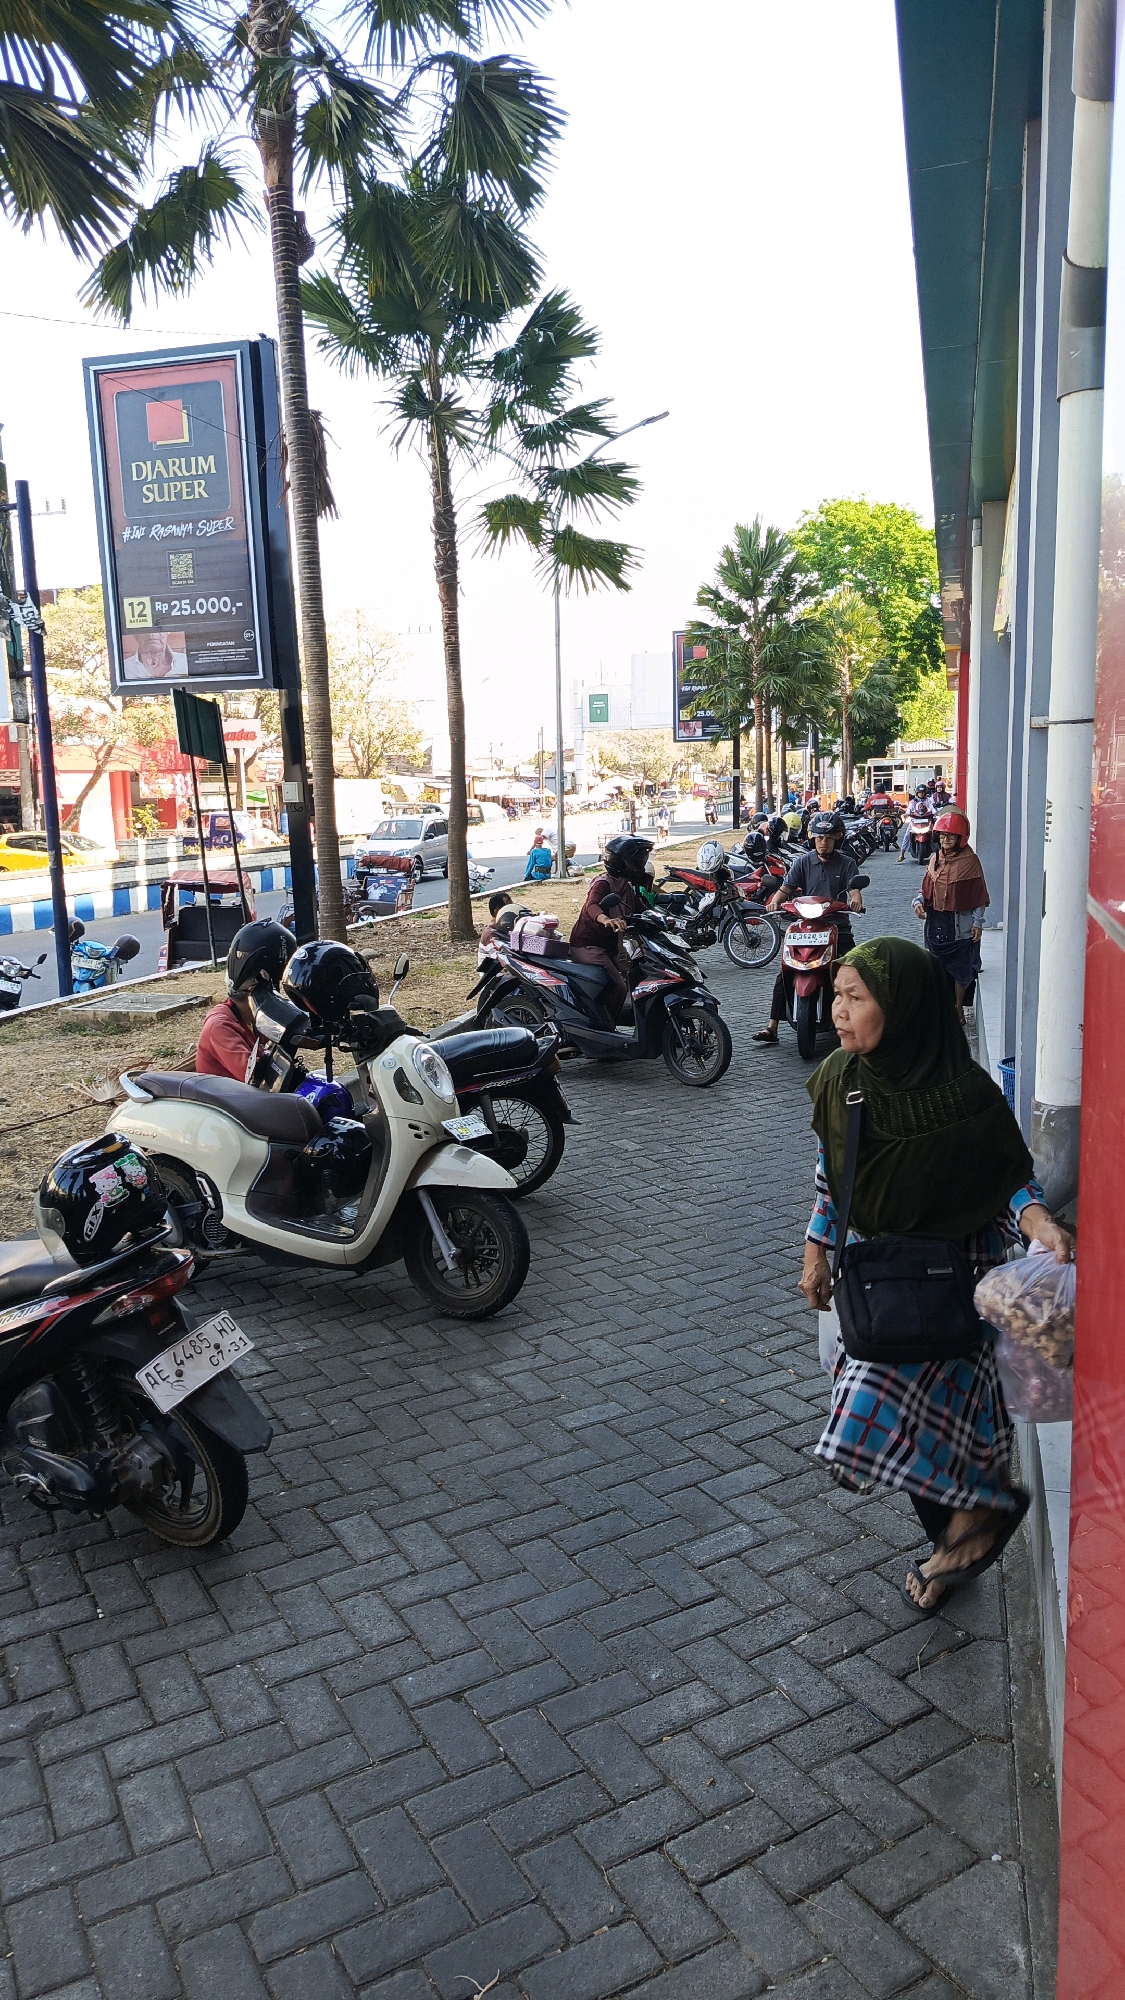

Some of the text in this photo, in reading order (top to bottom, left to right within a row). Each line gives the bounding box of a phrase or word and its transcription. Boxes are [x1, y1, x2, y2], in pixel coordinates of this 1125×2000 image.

[131, 455, 217, 482] DJARUM
[142, 480, 209, 503] SUPER
[148, 521, 194, 541] RASANYA
[196, 516, 236, 537] SUPER
[128, 597, 243, 618] 12 Rp 25.000,-
[144, 1362, 170, 1389] AE
[172, 1332, 212, 1366] 4485
